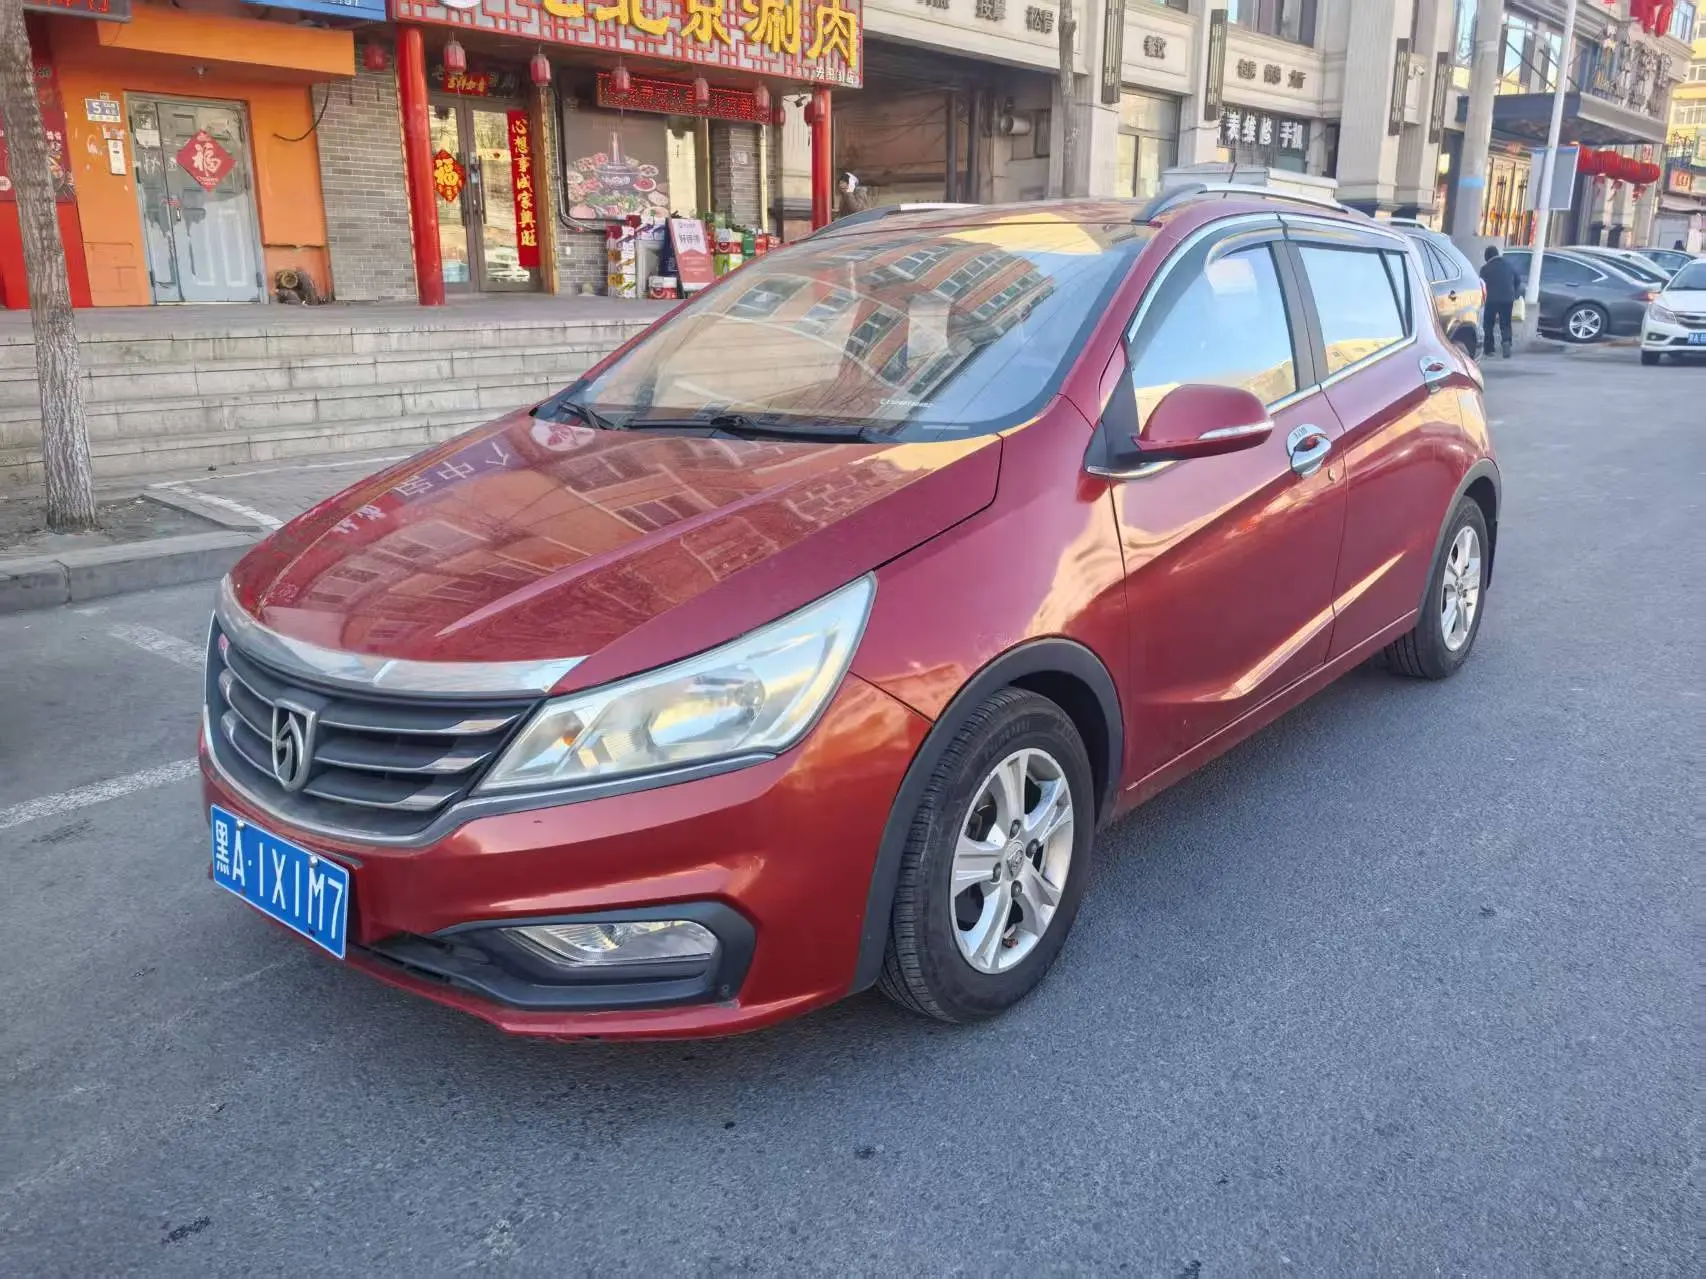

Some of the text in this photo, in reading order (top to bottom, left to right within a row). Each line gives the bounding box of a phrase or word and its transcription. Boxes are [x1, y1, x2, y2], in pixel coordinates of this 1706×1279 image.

[543, 0, 858, 67] 北京涮肉
[192, 142, 222, 177] 福
[434, 157, 459, 186] 福
